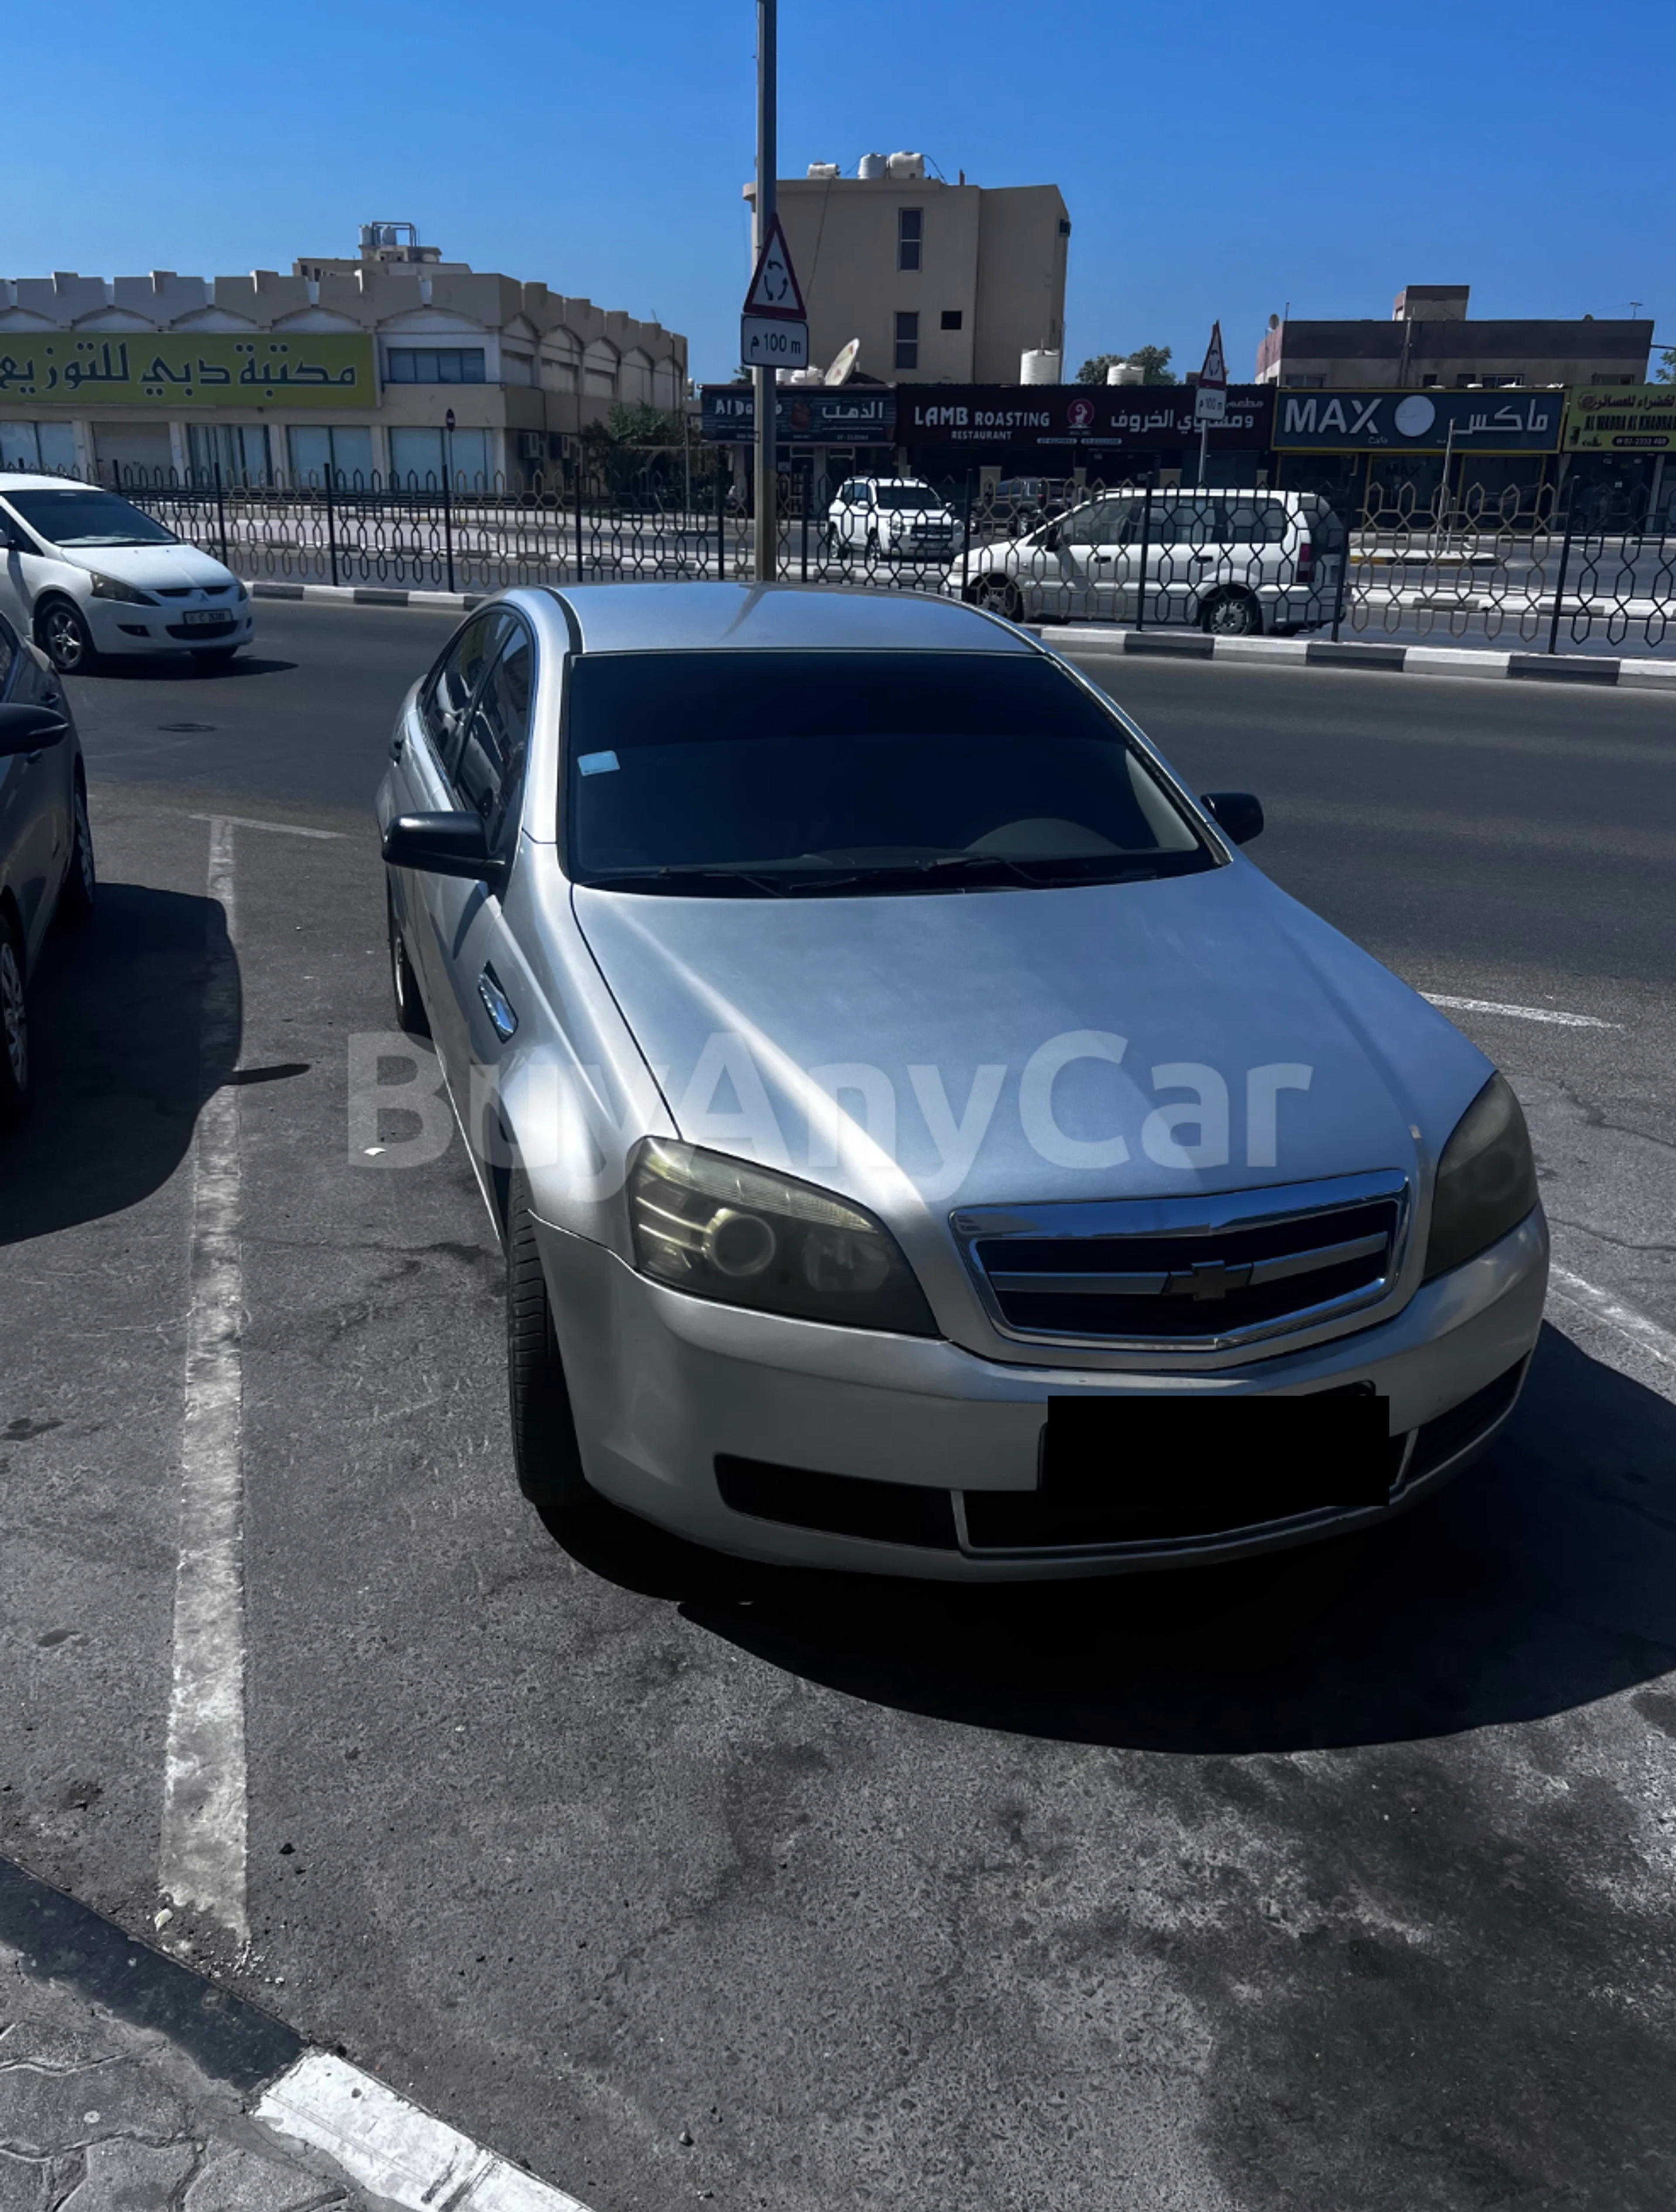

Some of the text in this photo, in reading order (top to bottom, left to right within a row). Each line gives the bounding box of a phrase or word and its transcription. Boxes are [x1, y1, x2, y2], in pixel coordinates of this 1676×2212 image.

[764, 333, 787, 352] 100
[791, 340, 801, 354] m
[0, 342, 356, 398] مكتبة دبي للتوزيع
[821, 401, 884, 422] الذهب
[915, 406, 1051, 427] LAMB ROASTING
[1111, 409, 1174, 432] الخروف
[1284, 398, 1383, 434] MAX
[1451, 398, 1549, 435] ماكس
[951, 430, 1013, 440] RESTAURANT
